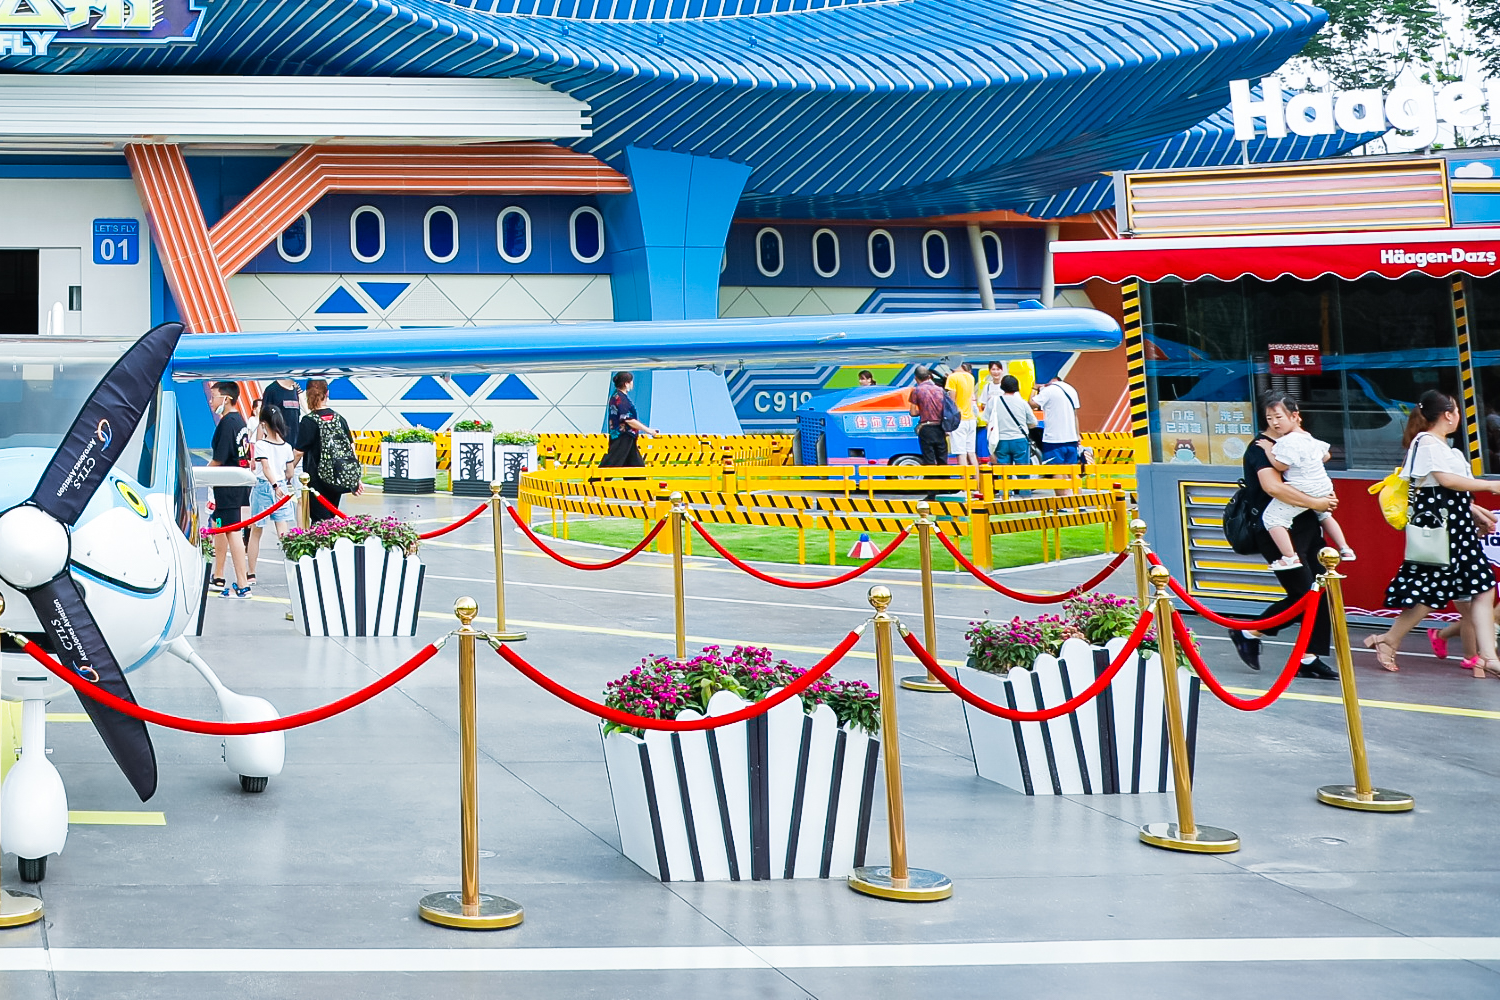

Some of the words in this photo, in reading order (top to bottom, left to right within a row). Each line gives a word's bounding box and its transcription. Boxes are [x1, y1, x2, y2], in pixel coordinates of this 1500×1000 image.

[95, 224, 119, 233] LET'S
[120, 224, 137, 233] FLY
[100, 238, 129, 261] 01
[1380, 248, 1497, 268] Häagen-Dazs
[1273, 354, 1316, 366] 取餐区
[1171, 410, 1195, 421] 门店
[1220, 410, 1245, 422] 洗手
[1166, 422, 1202, 434] 已消毒
[1215, 422, 1252, 435] 消毒区
[73, 457, 96, 490] CTLS
[56, 468, 77, 497] Aviation
[53, 598, 72, 628] Aviation
[50, 619, 73, 651] CTLS
